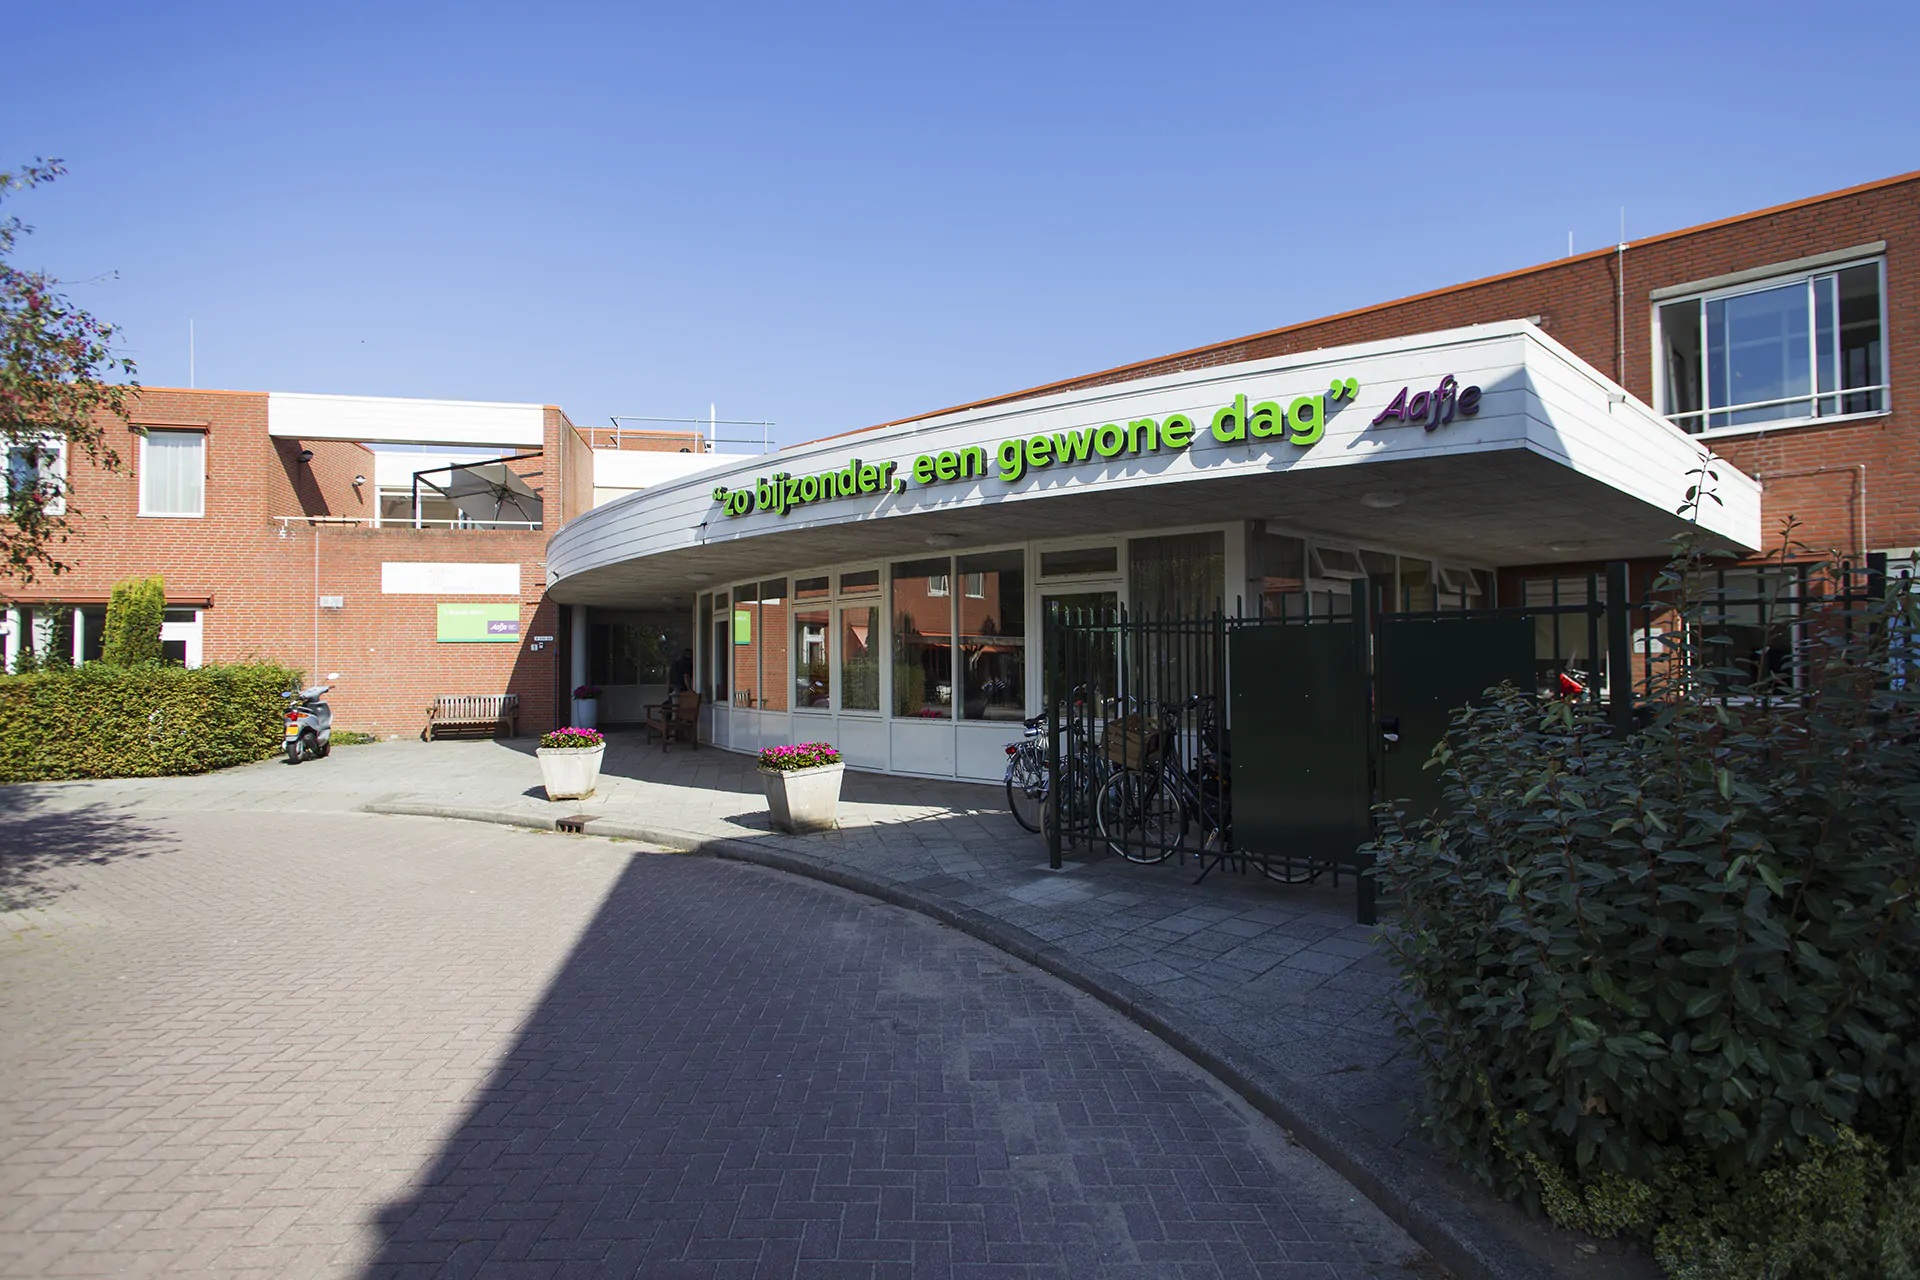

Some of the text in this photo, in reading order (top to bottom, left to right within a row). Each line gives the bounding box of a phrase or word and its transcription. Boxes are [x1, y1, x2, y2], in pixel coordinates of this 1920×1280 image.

[1372, 373, 1482, 432] Aafje
[756, 458, 902, 515] bijzonder,
[912, 445, 985, 484] een
[997, 413, 1193, 482] gewone
